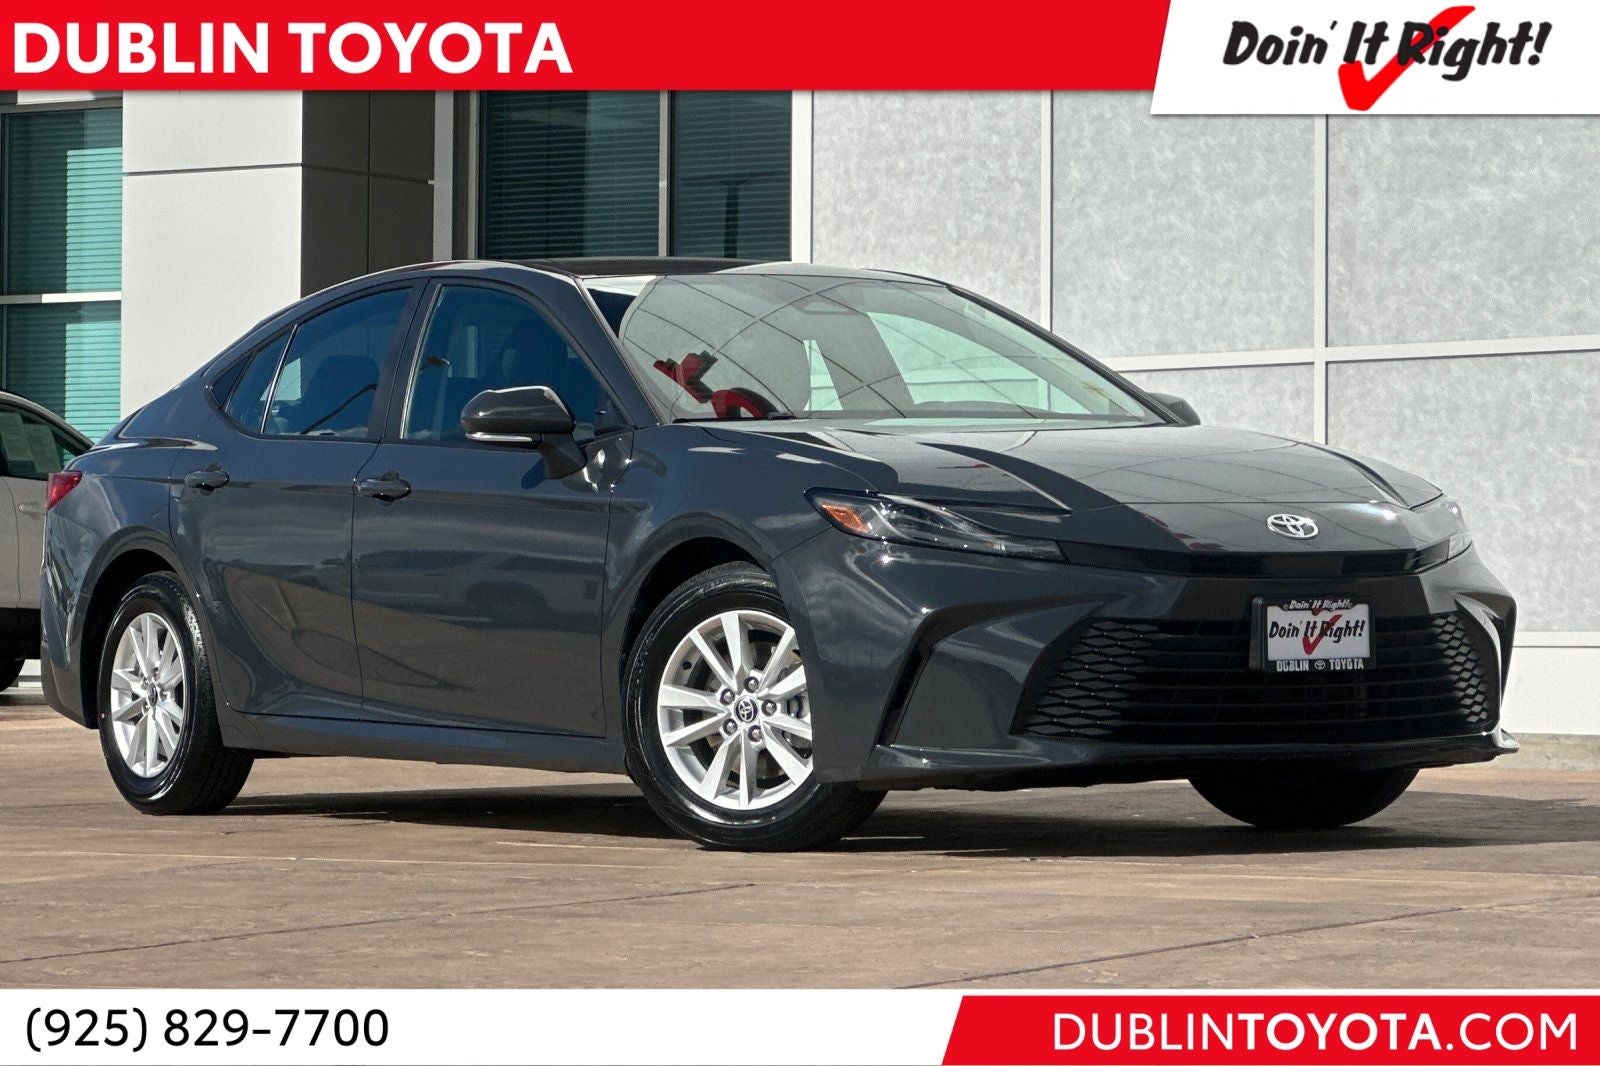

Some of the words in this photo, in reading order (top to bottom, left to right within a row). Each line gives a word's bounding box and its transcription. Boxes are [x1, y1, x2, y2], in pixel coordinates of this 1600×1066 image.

[1269, 620, 1303, 638] Doin'
[1304, 620, 1318, 637] It
[1320, 620, 1366, 643] Right!
[1276, 659, 1310, 672] DUBLIN
[1329, 658, 1364, 670] TOYOTA
